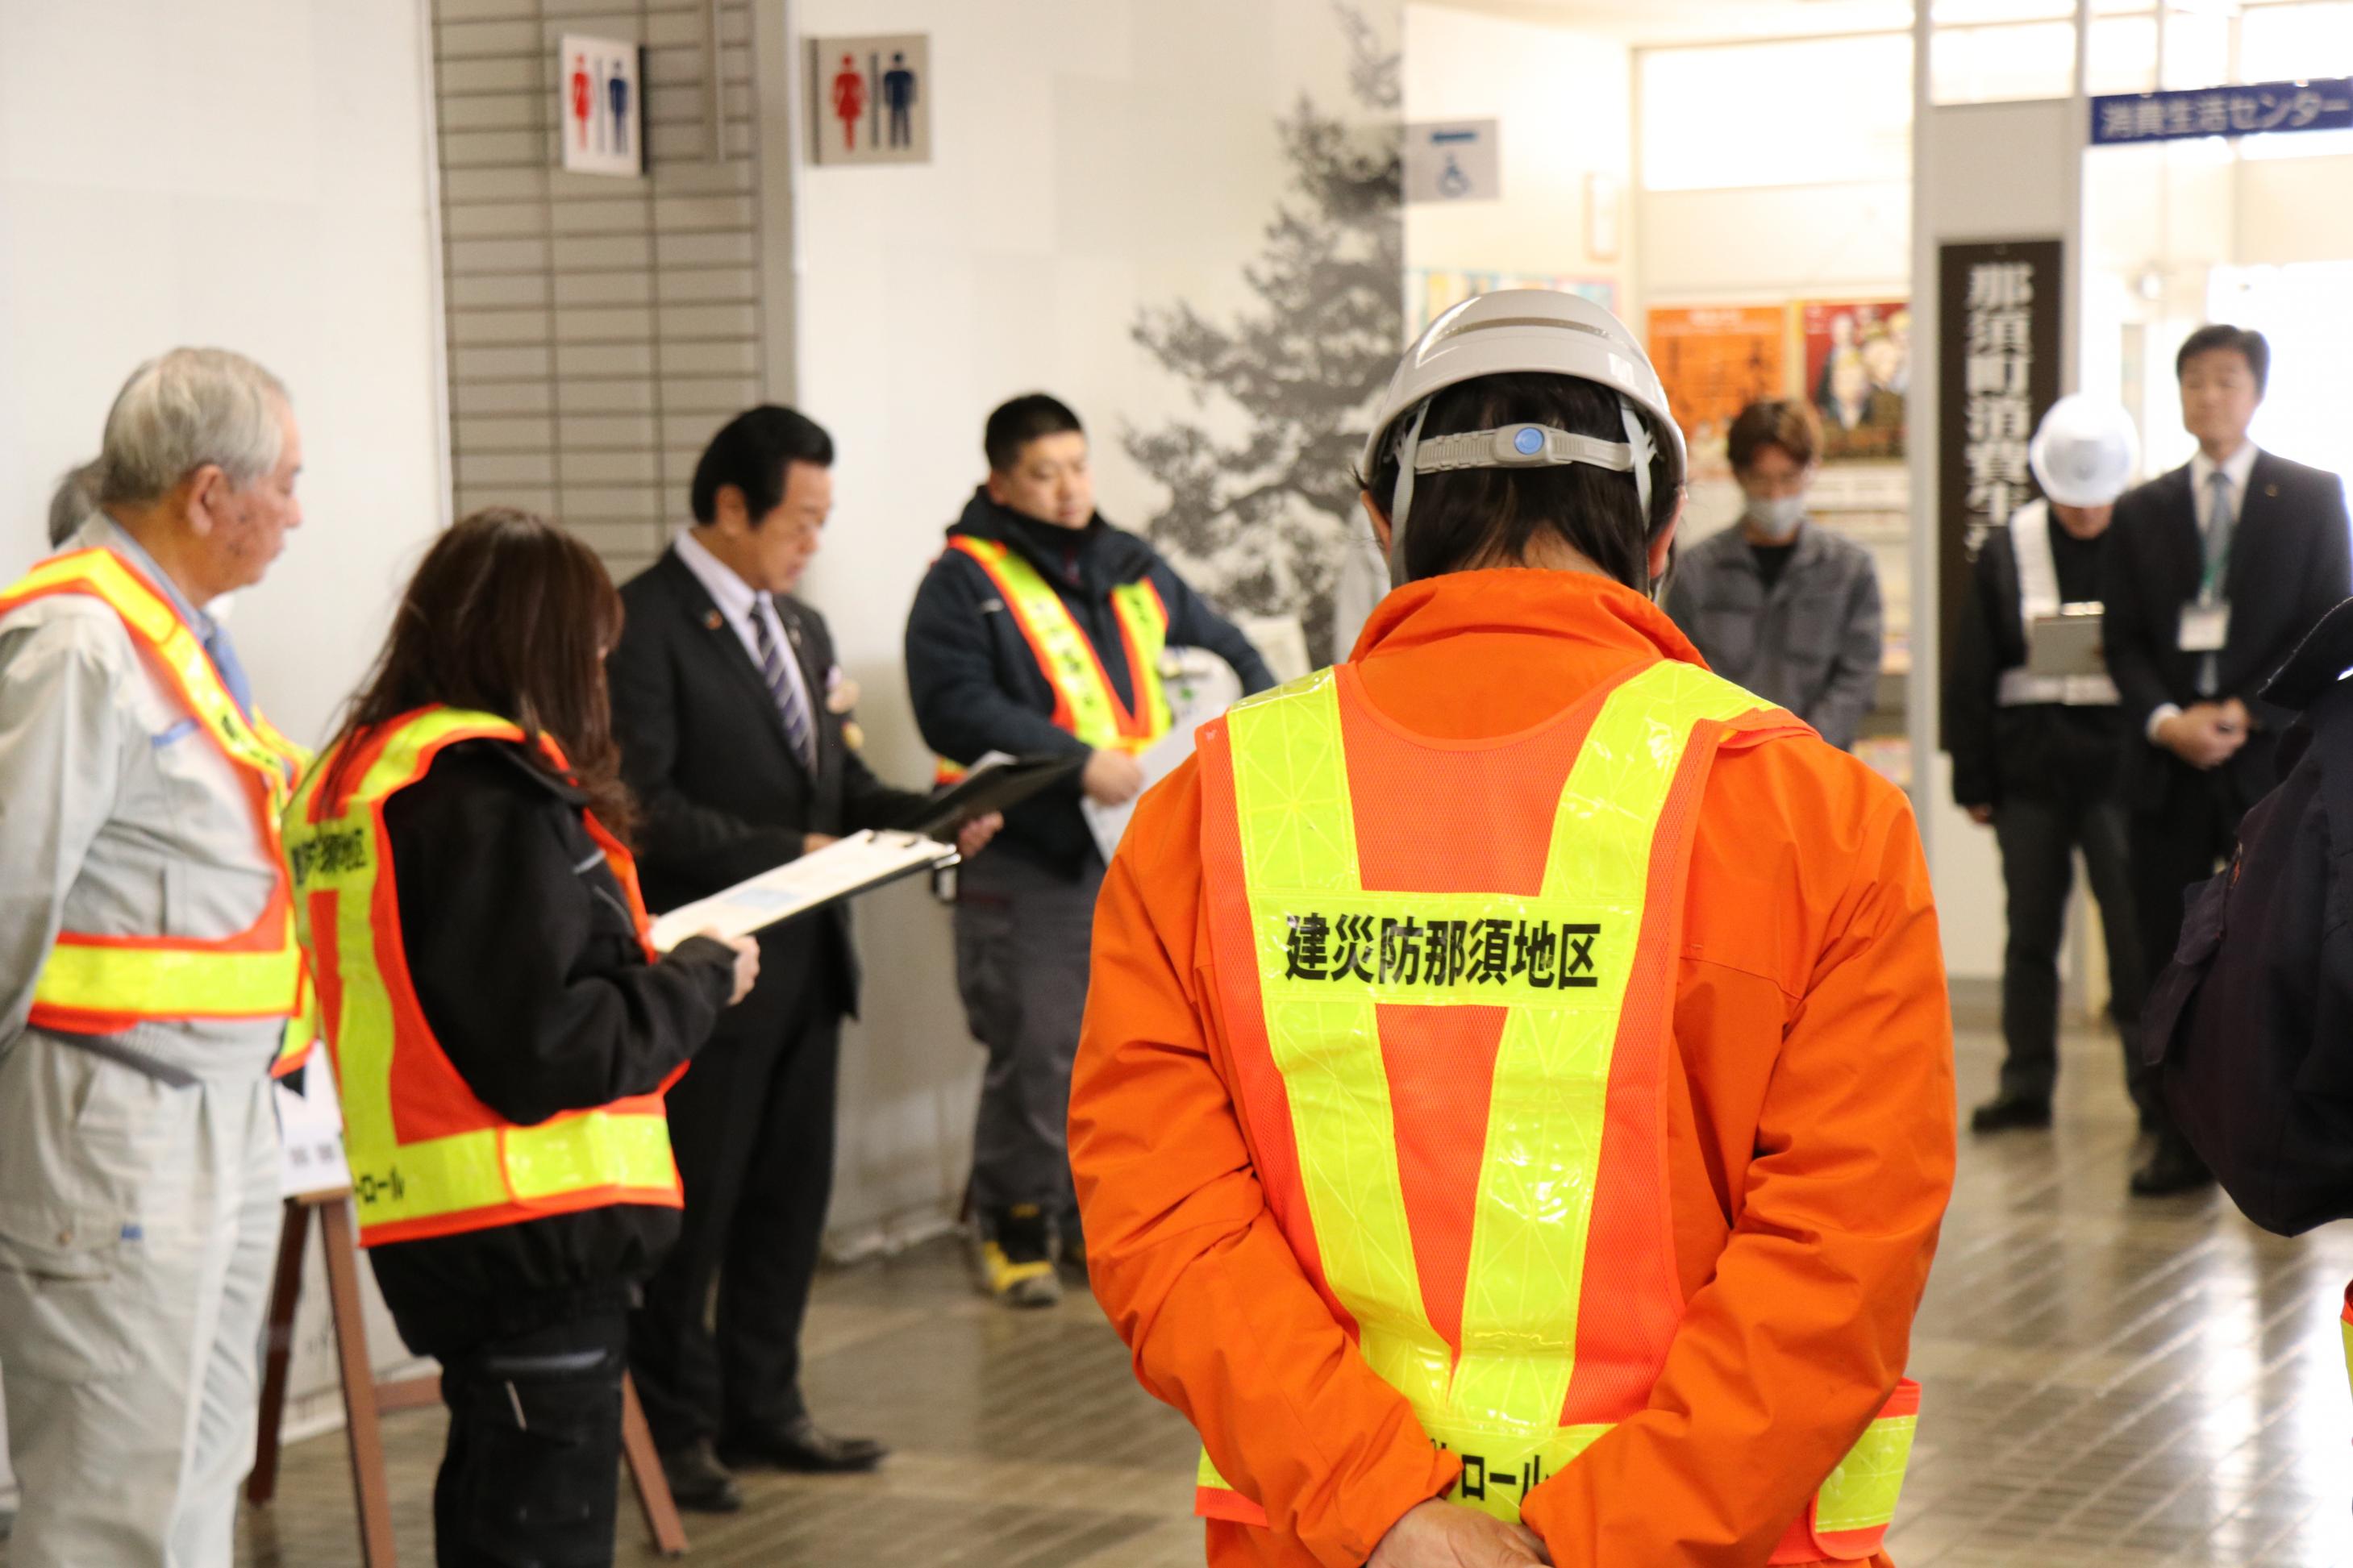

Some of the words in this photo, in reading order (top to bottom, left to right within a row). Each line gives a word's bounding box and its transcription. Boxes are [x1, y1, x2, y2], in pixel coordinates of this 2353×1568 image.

[1966, 263, 2033, 562] 那須町消費生
[1285, 912, 1601, 990] 建災防那須地区
